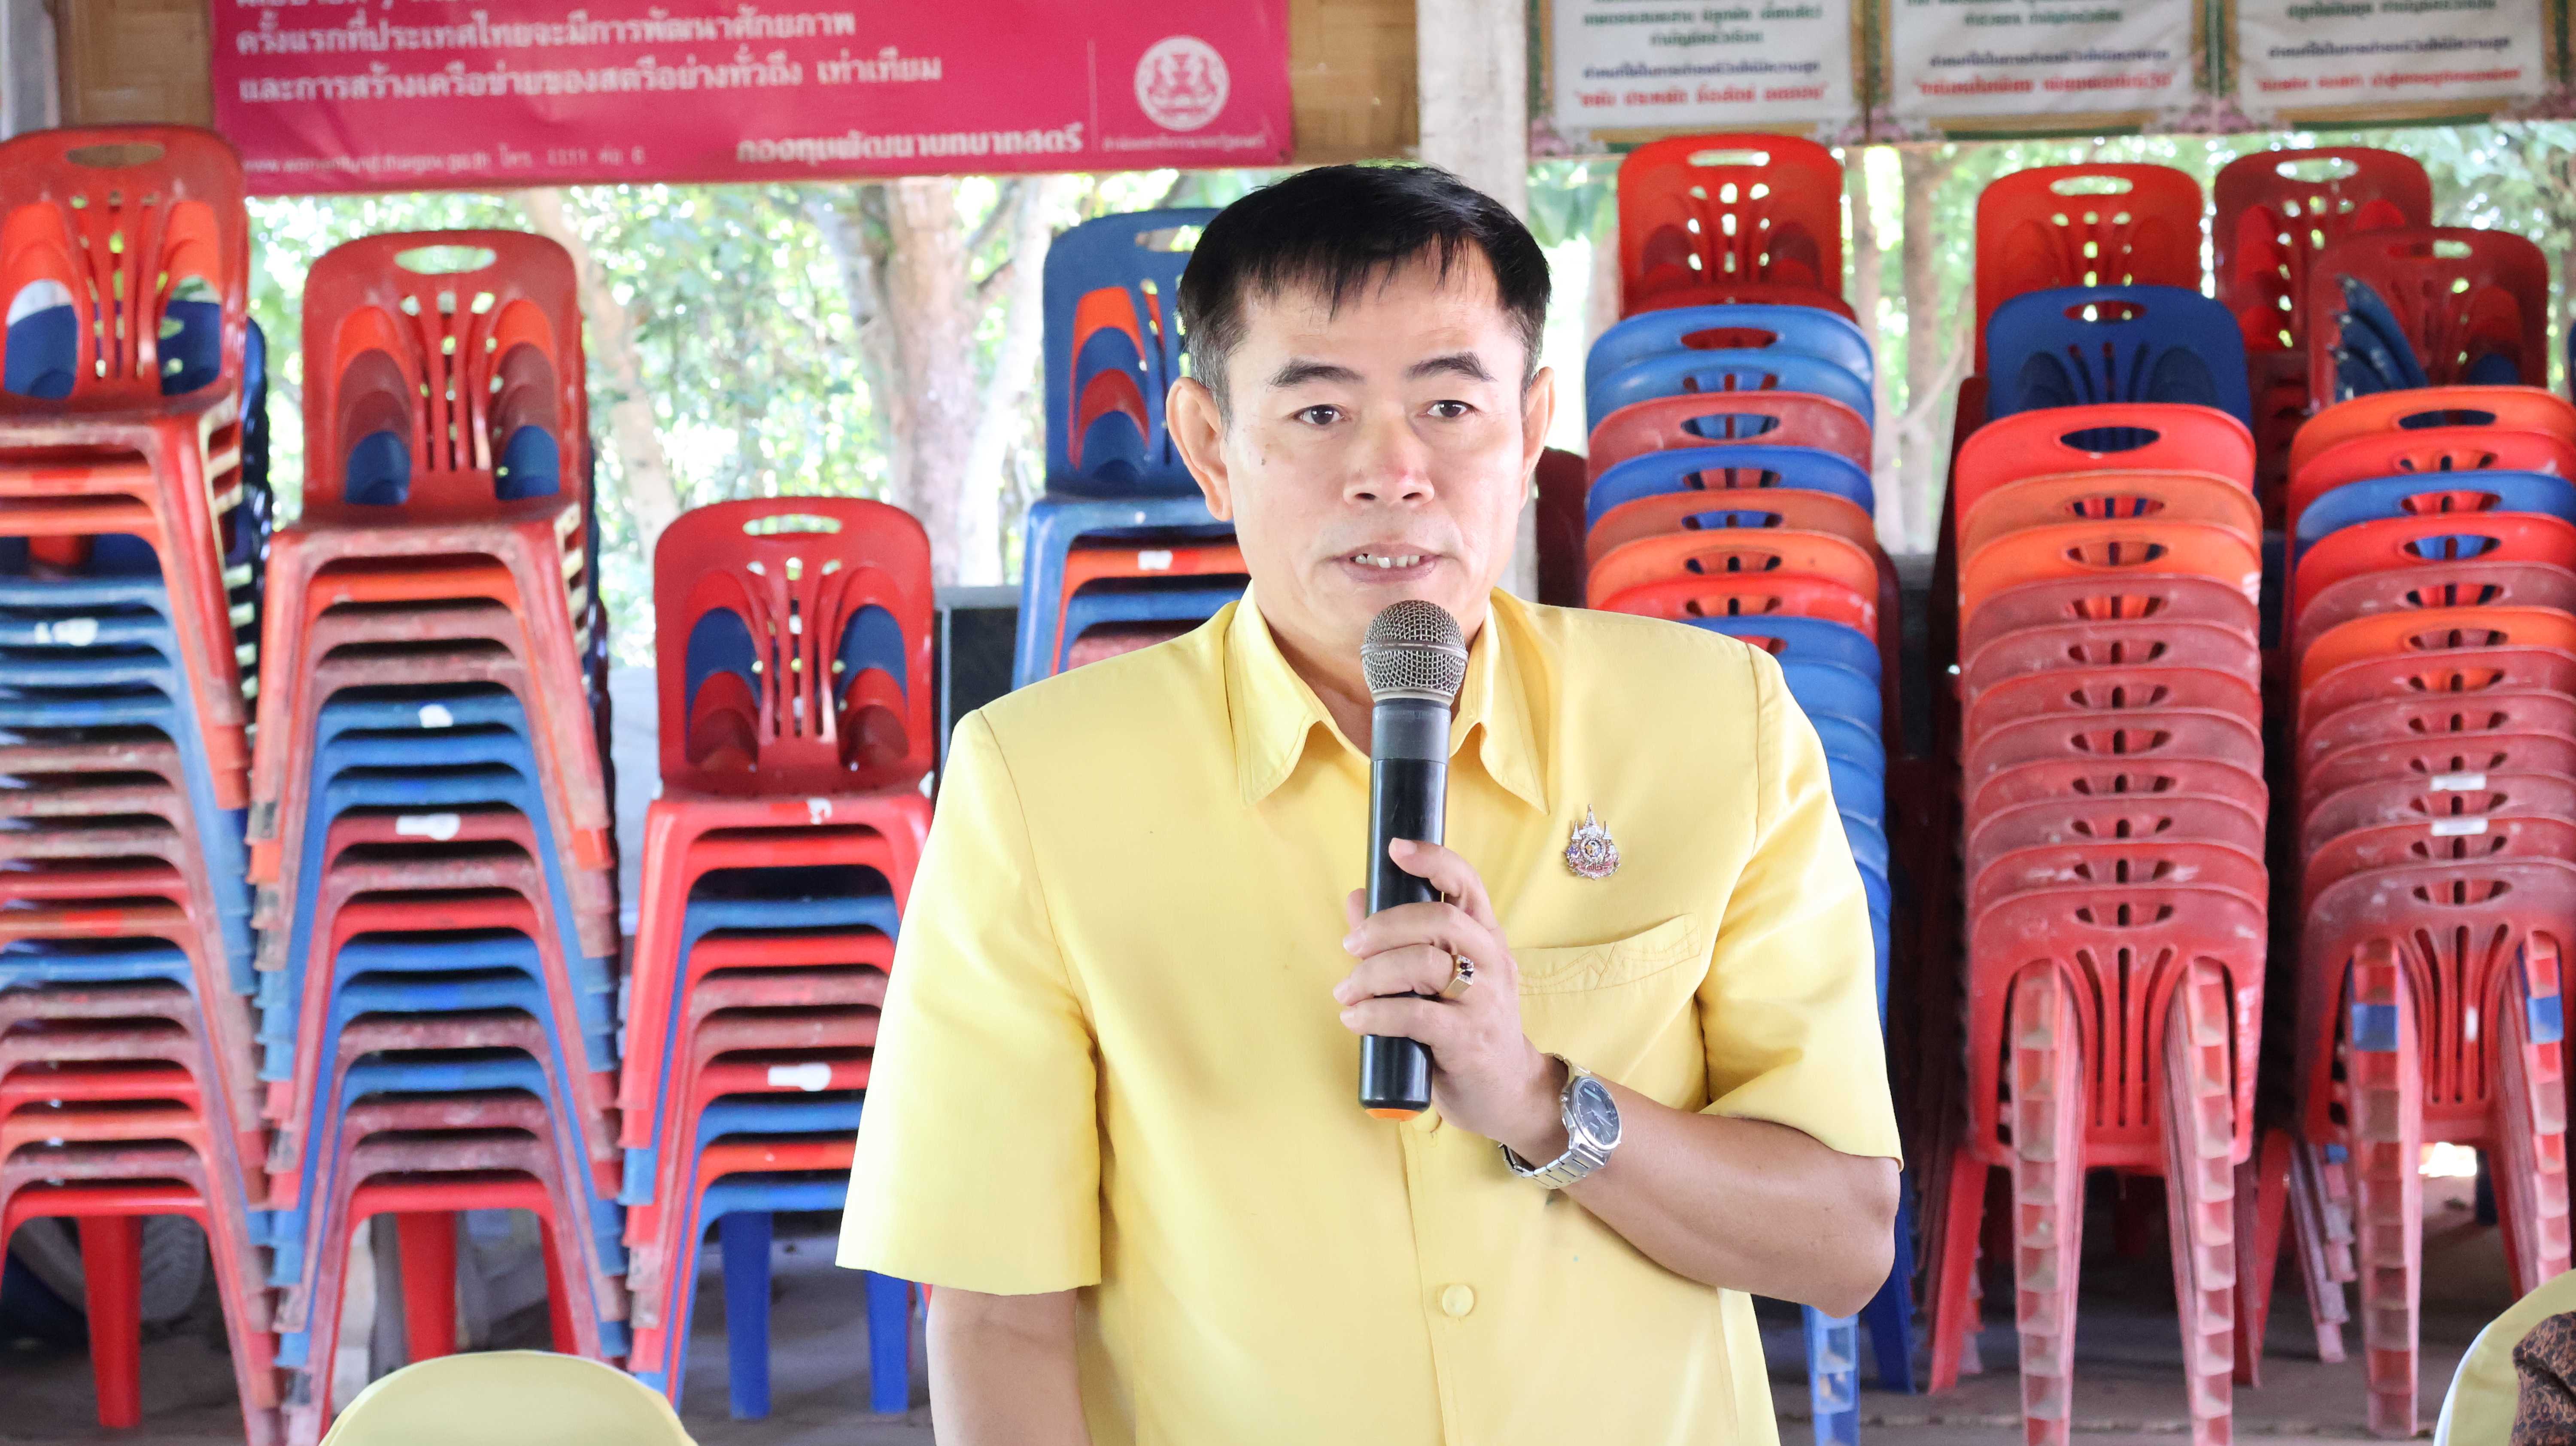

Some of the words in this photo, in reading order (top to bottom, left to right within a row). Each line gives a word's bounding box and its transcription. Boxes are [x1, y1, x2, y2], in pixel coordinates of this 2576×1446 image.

[817, 46, 943, 84] เท่าเทียม
[631, 145, 646, 166] 6
[737, 122, 1084, 165] กองทุนพัฒนาบทบาทสตรี
